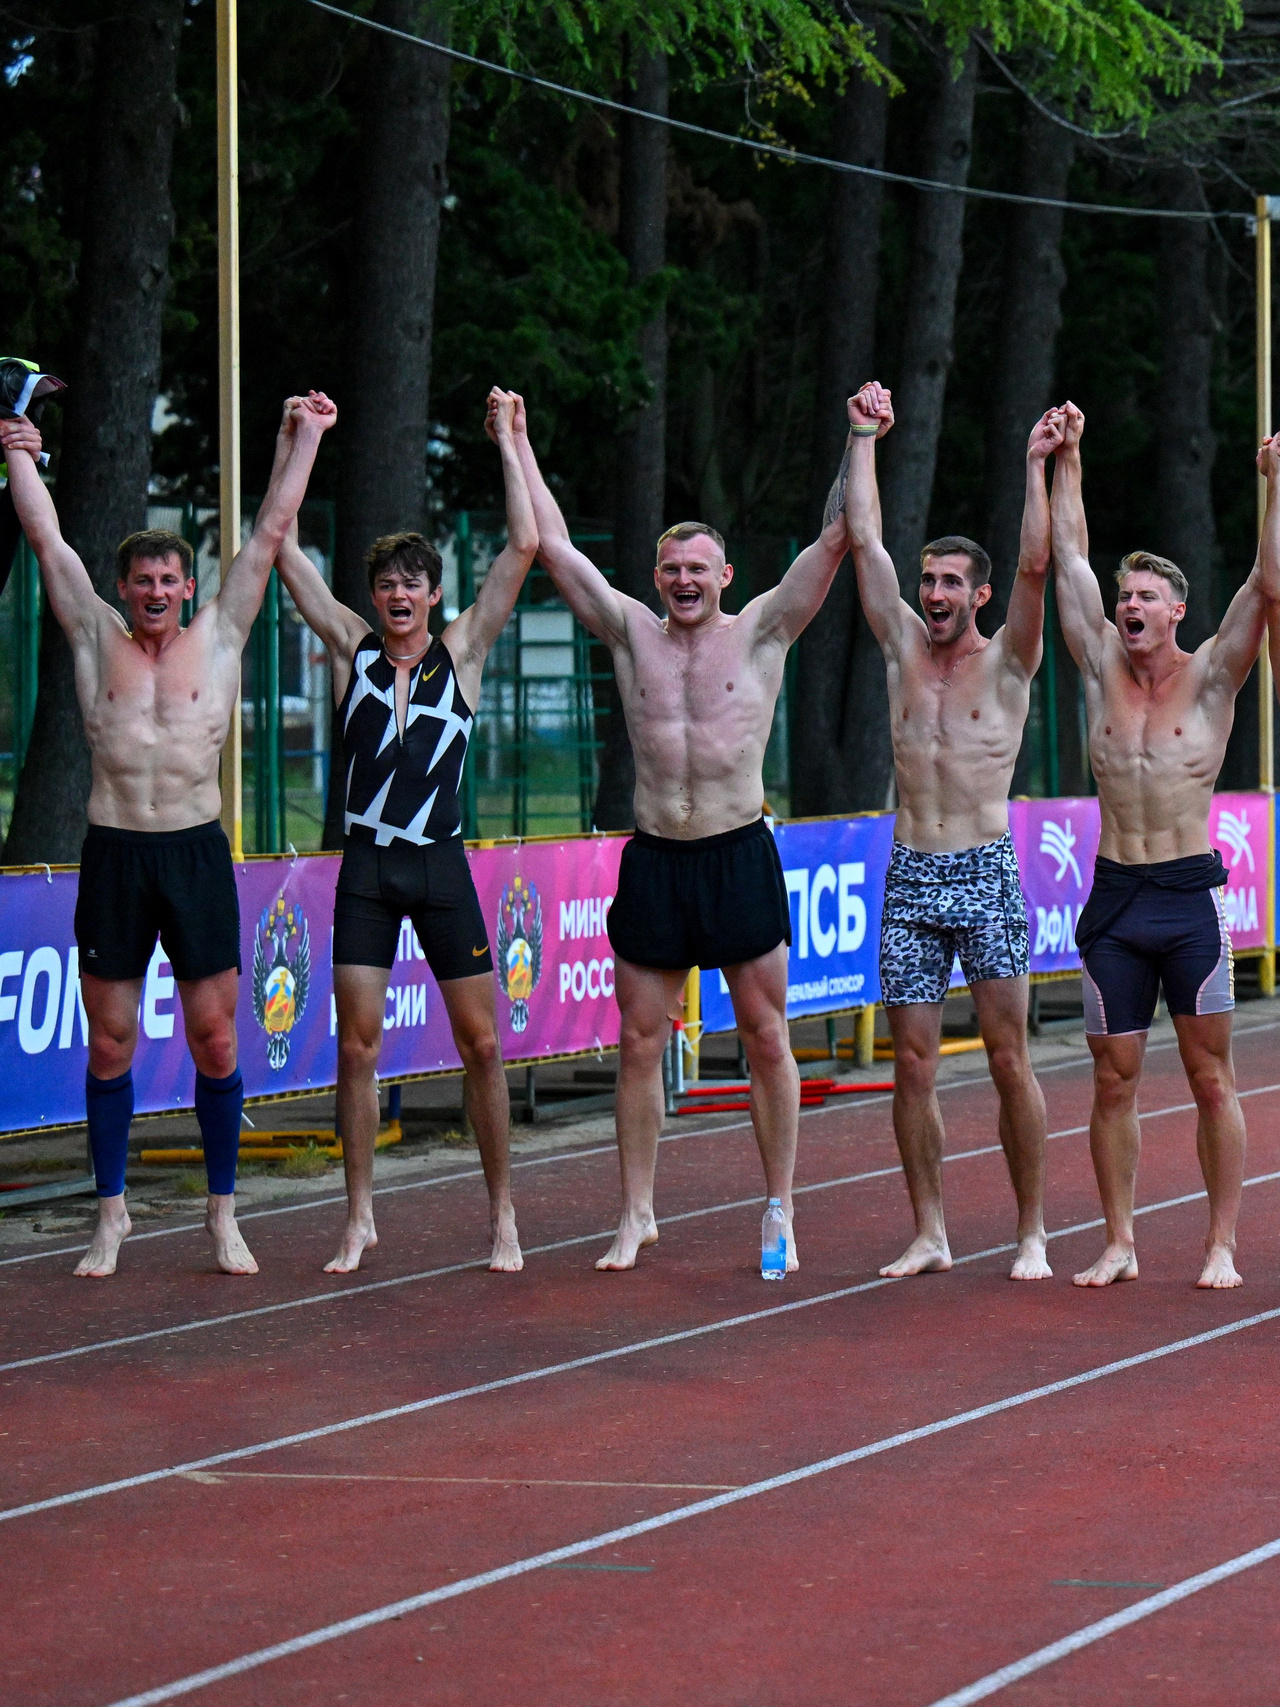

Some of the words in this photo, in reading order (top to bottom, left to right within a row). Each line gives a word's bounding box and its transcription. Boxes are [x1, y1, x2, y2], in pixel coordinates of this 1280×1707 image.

[783, 862, 867, 960] ПСБ
[1224, 886, 1259, 932] ФЛА
[560, 957, 615, 1003] РОСС
